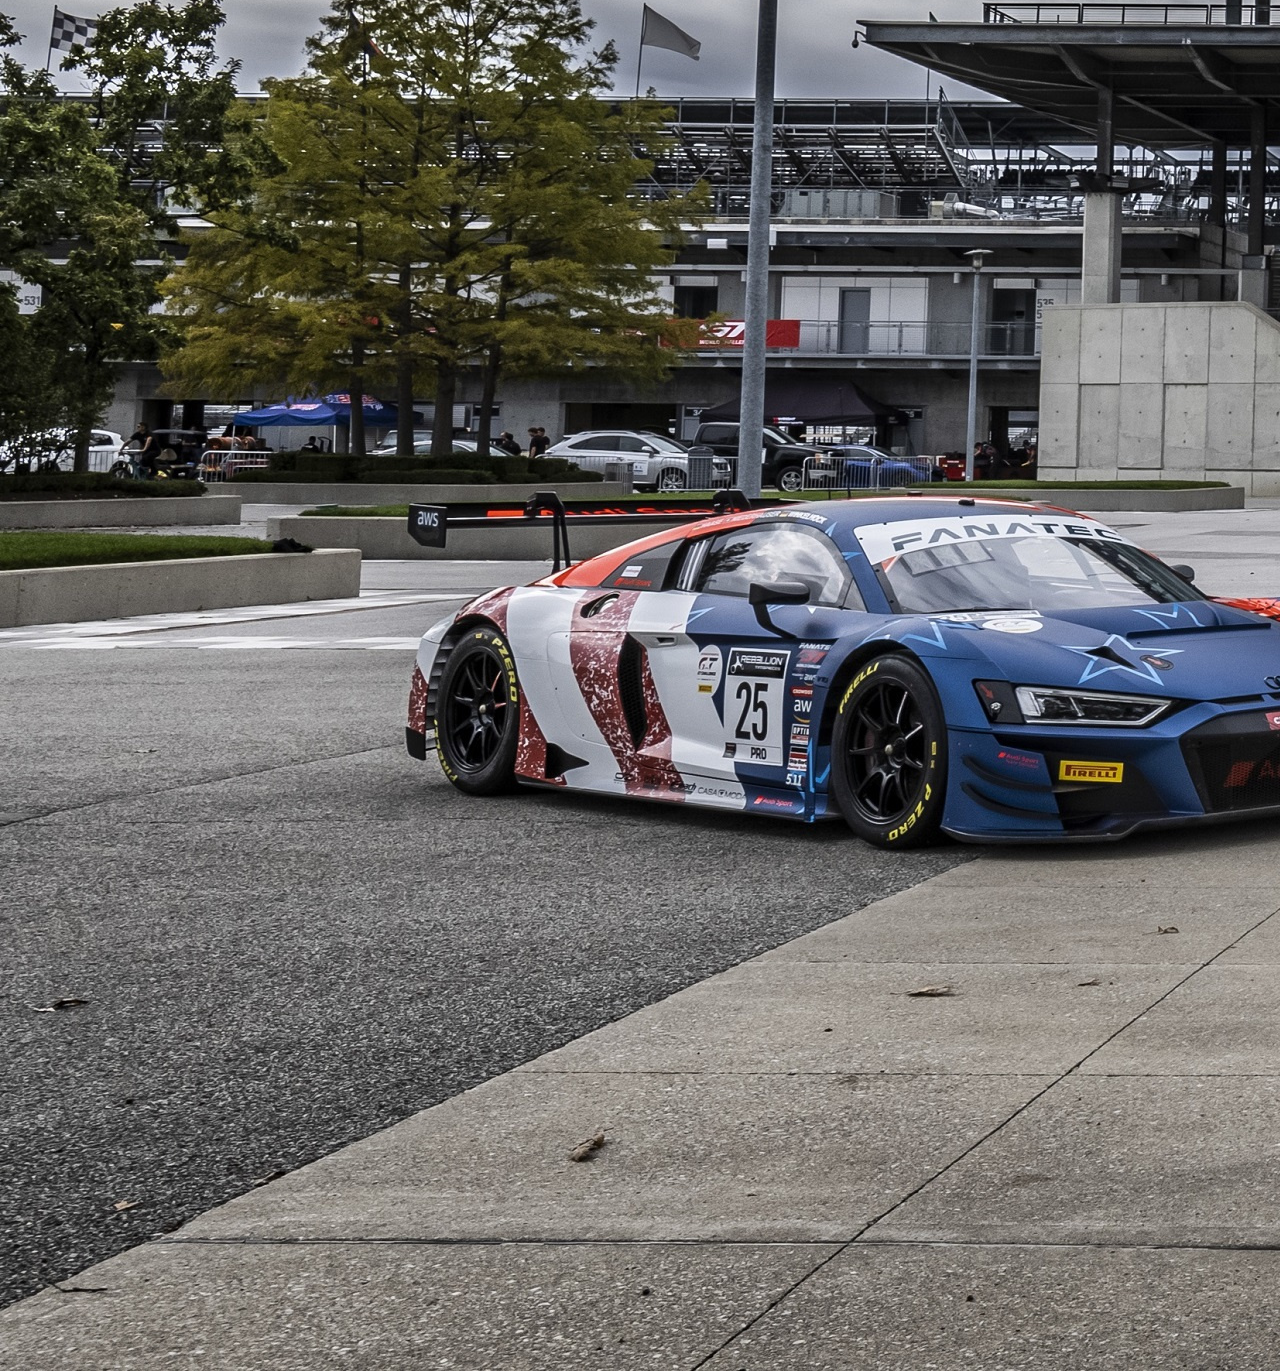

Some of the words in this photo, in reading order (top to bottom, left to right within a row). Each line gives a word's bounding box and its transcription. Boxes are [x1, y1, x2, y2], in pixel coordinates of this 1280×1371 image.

[417, 510, 439, 527] aws
[891, 522, 1123, 552] FANATEC
[740, 654, 784, 666] REBELLION
[839, 661, 880, 714] PIRELLI
[734, 680, 769, 742] 25
[793, 699, 813, 713] aw
[750, 746, 767, 760] PRO
[1064, 764, 1118, 779] PIRELLI
